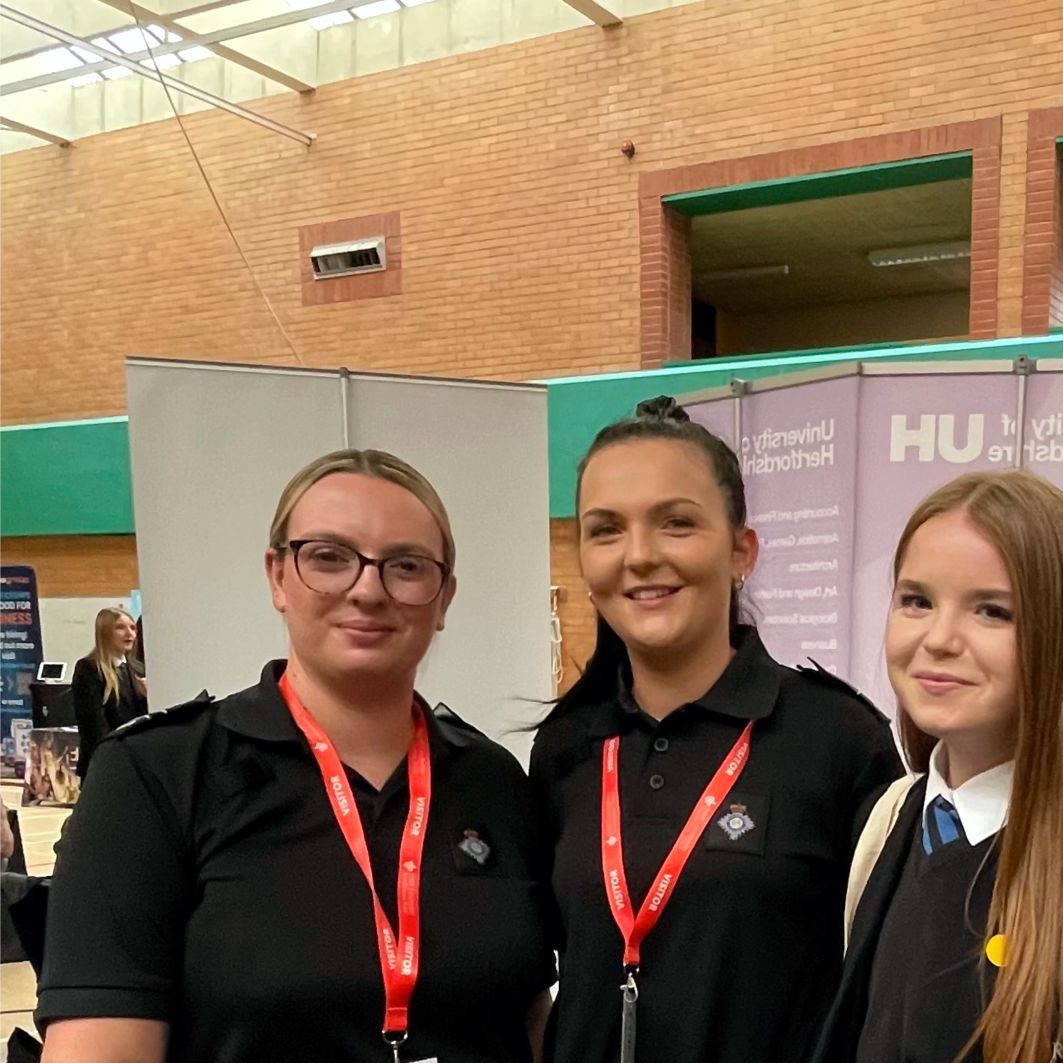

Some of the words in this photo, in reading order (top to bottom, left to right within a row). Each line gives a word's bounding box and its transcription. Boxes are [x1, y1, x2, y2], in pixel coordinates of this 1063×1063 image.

[331, 776, 350, 816] VISITOR
[411, 796, 426, 836] VISITOR
[609, 870, 624, 910] VISITOR
[648, 873, 672, 912] VISITOR
[401, 936, 414, 976] VISITOR
